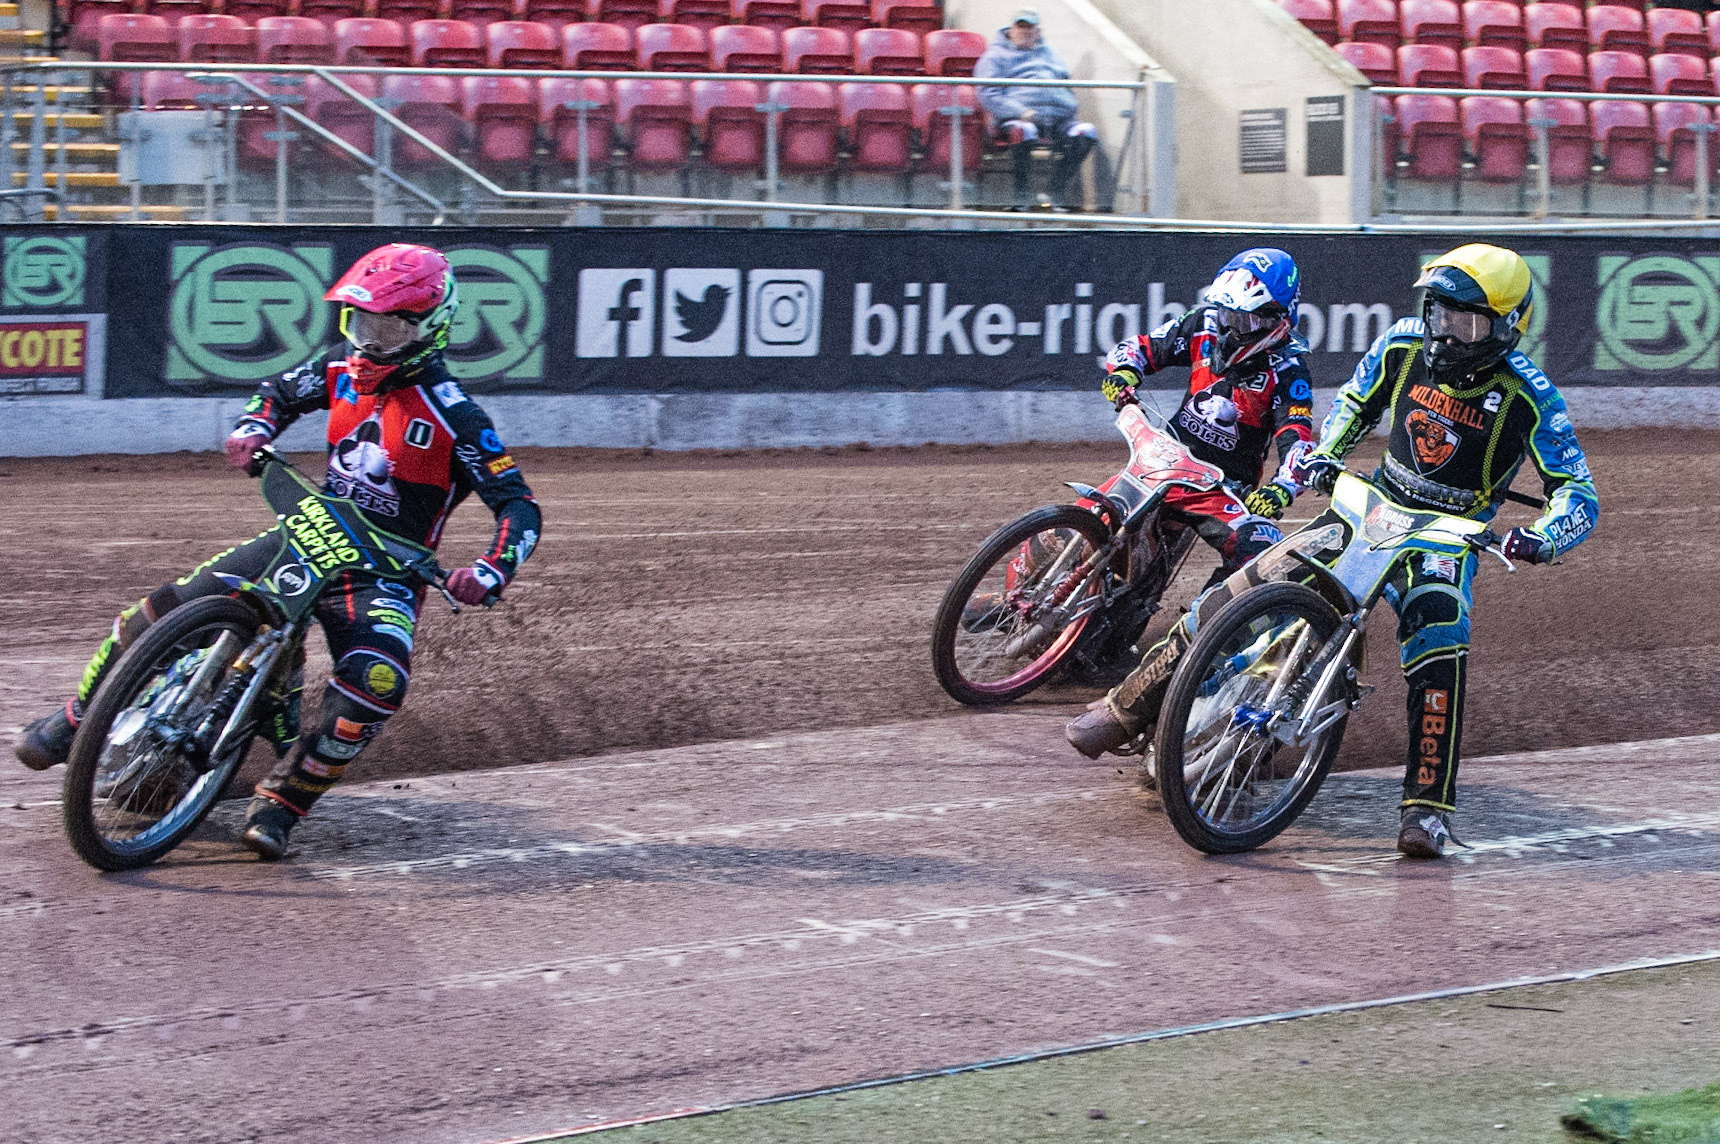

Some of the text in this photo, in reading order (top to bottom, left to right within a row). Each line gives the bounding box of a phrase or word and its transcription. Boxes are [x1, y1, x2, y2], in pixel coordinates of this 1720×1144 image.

[0, 329, 83, 368] COTE
[1509, 355, 1551, 391] DAD
[1407, 384, 1484, 430] MILDENHALL
[1483, 391, 1502, 413] 2
[1180, 411, 1238, 451] COLTS
[1411, 492, 1466, 512] RECOVERY
[1549, 502, 1587, 539] PLANET
[285, 514, 341, 570] CARPETS
[297, 496, 360, 562] KIRKLAND
[1417, 715, 1447, 785] Beta
